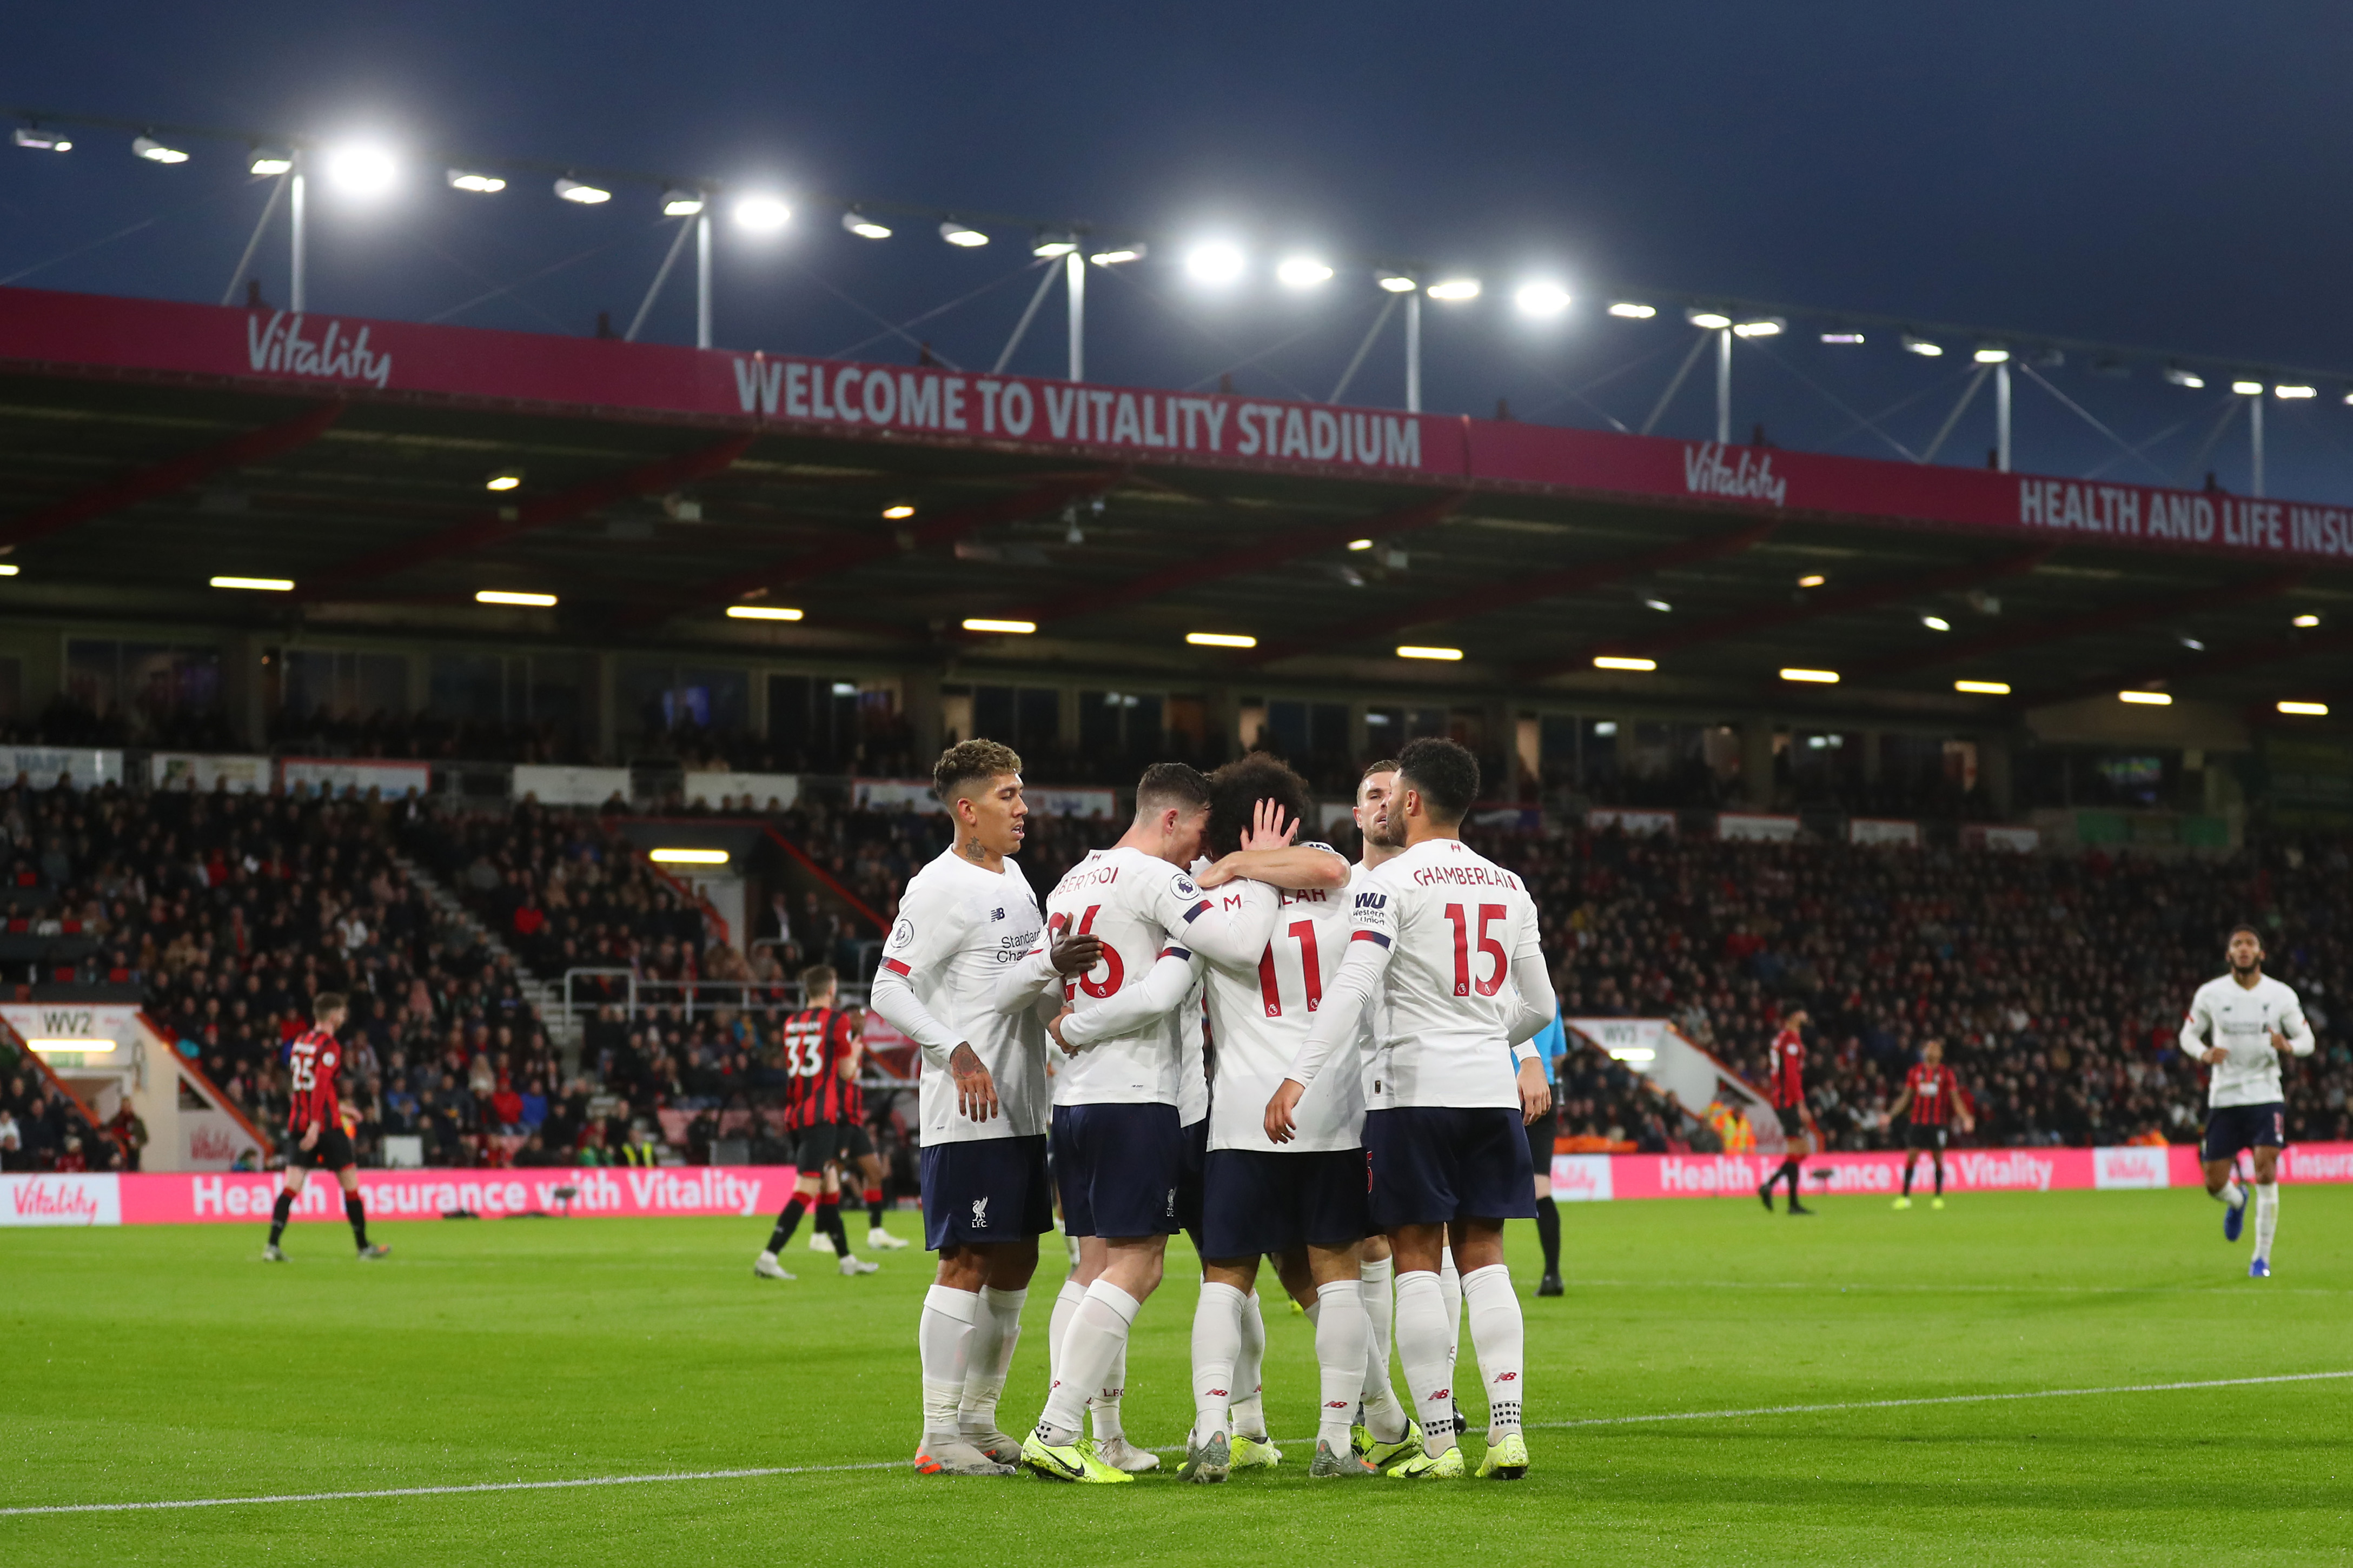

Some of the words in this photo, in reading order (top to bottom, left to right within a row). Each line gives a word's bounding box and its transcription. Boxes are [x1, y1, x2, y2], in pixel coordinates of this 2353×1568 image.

[248, 310, 391, 389] Vitality
[733, 358, 967, 431] WELCOME
[976, 380, 1033, 436] TO
[1044, 386, 1228, 451] VITALITY
[1237, 403, 1421, 468] STADIUM
[1685, 441, 1787, 507] Vitality
[2019, 479, 2140, 535] HEALTH
[2147, 492, 2216, 541] AND
[2221, 499, 2284, 548] LIFE
[1353, 909, 1384, 918] Western
[1355, 893, 1387, 909] WU
[1360, 916, 1384, 926] Union
[1258, 920, 1322, 1018] 11
[1444, 903, 1507, 996] 15
[43, 1011, 91, 1034] WV2
[785, 1035, 823, 1078] 33
[627, 1167, 761, 1217] Vitality
[1659, 1155, 1753, 1192] Health
[1958, 1151, 2054, 1192] Vitality
[14, 1174, 97, 1225] Vitality
